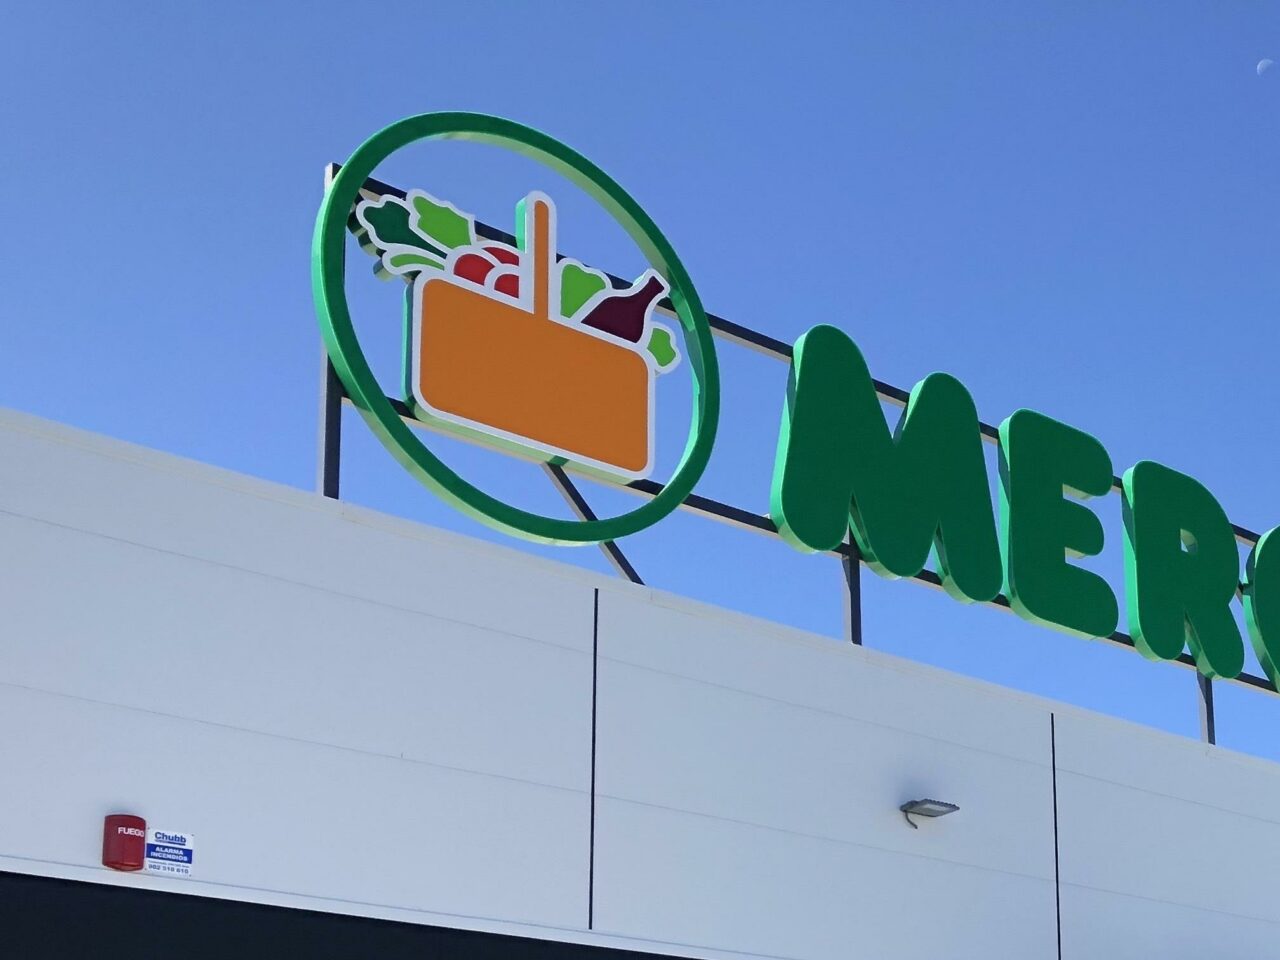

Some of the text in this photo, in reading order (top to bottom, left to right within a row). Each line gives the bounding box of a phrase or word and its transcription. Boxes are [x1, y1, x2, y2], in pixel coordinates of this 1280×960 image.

[118, 827, 144, 837] FUEGO
[155, 832, 186, 842] Chubb
[150, 851, 188, 861] INCENDIOS
[155, 847, 184, 855] ALARMA
